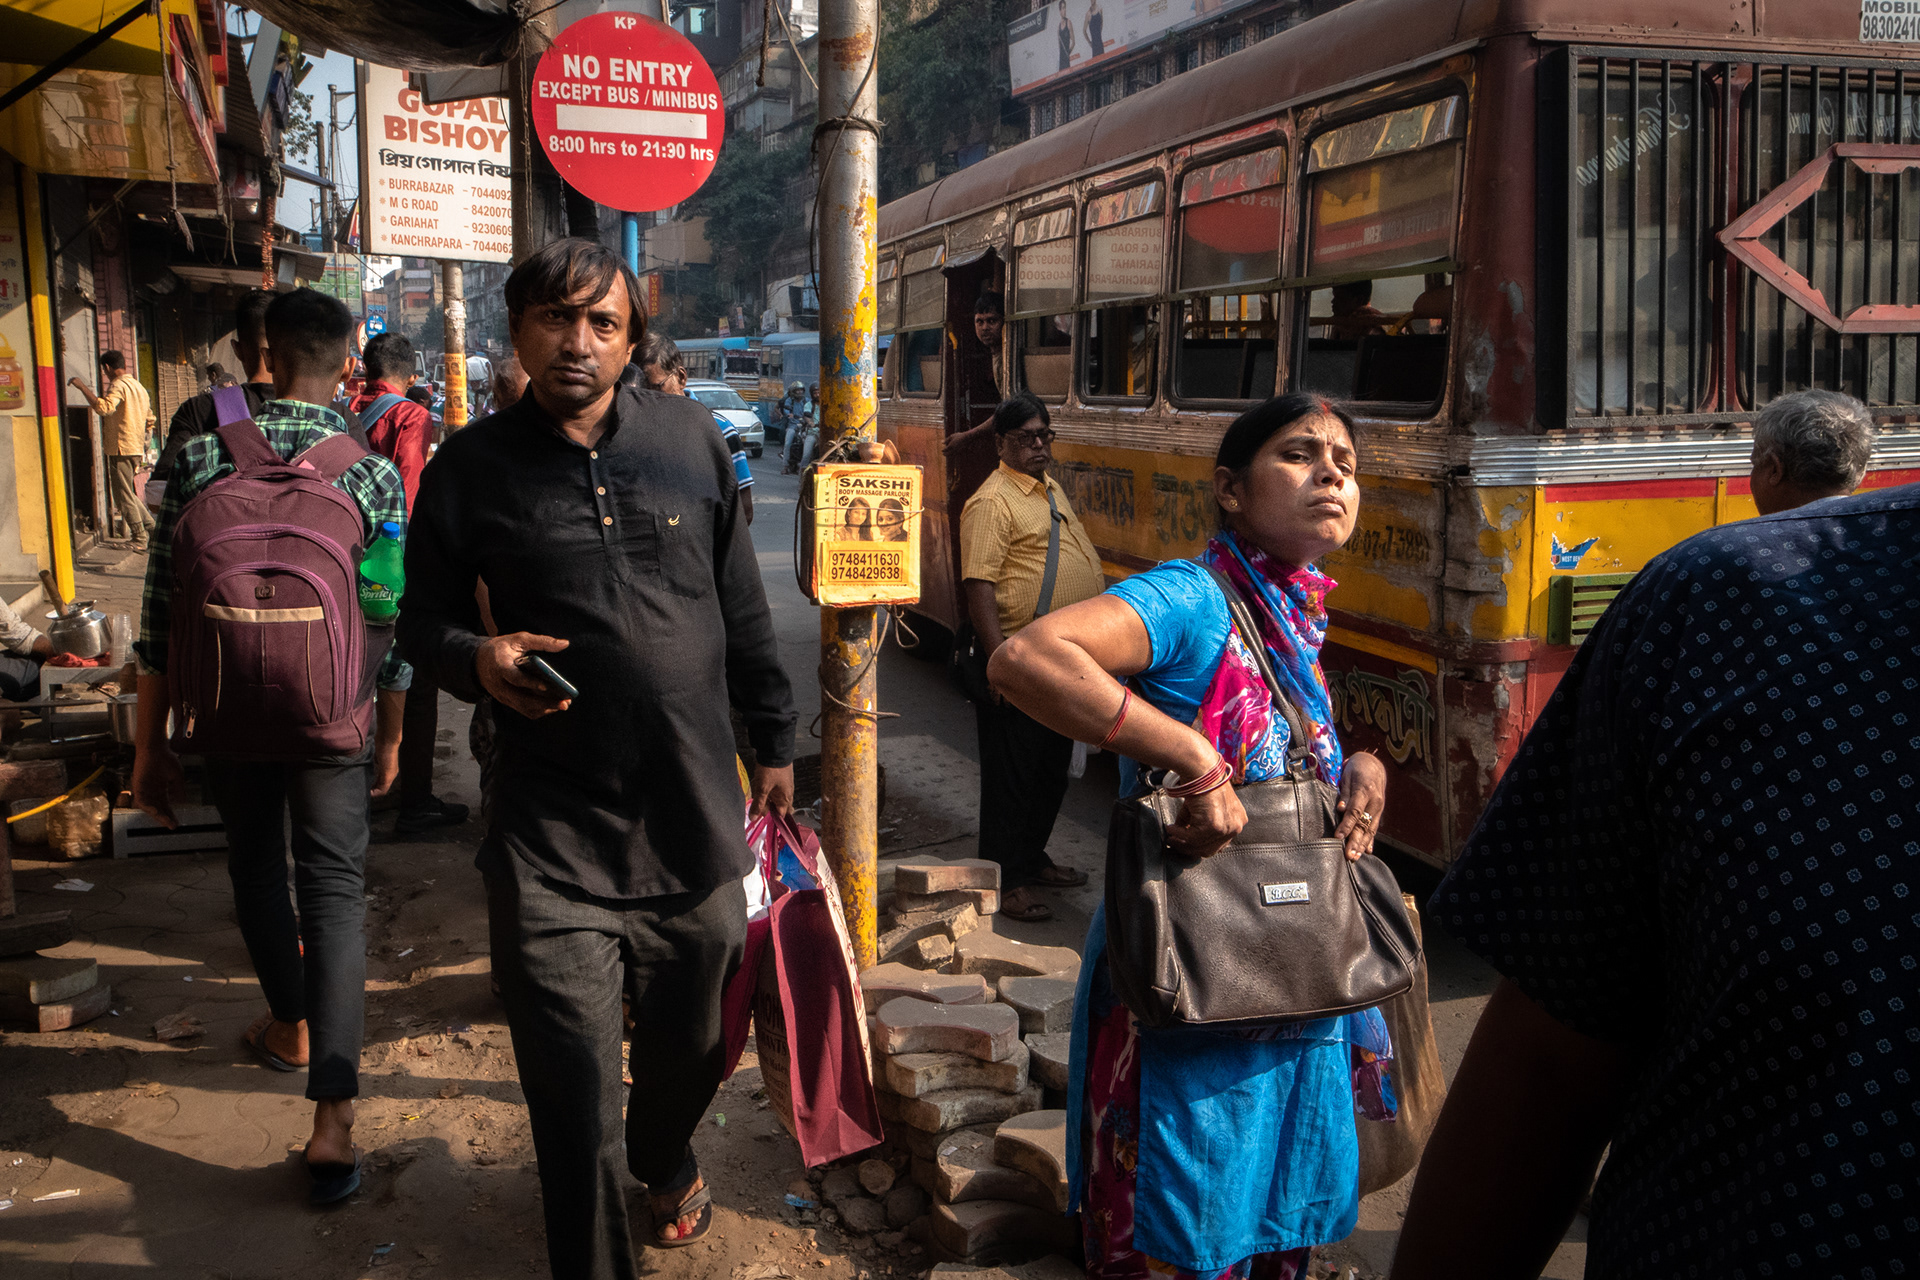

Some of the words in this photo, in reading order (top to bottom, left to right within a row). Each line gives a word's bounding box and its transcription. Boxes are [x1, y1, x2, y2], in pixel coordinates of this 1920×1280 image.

[614, 16, 637, 30] KP
[563, 54, 600, 79] NO
[609, 57, 693, 87] ENTRY
[538, 80, 602, 102] EXCEPT
[607, 86, 639, 105] BUS
[384, 114, 509, 153] BISHOY
[549, 135, 585, 153] 8:00
[589, 137, 616, 155] hrs
[621, 140, 638, 156] to
[642, 141, 686, 159] 21:30
[690, 144, 714, 161] hrs
[416, 156, 476, 175] গোপাল
[388, 178, 455, 195] BURRABAZAR
[389, 196, 398, 208] M
[402, 198, 409, 209] G
[411, 199, 439, 212] ROAD
[390, 215, 439, 230] GARIAHAT
[391, 233, 463, 250] KANCHRAPARA
[839, 478, 911, 490] SAKSHI
[832, 553, 900, 566] 9748411630
[831, 567, 900, 579] 9748429638
[360, 586, 391, 600] Sprite
